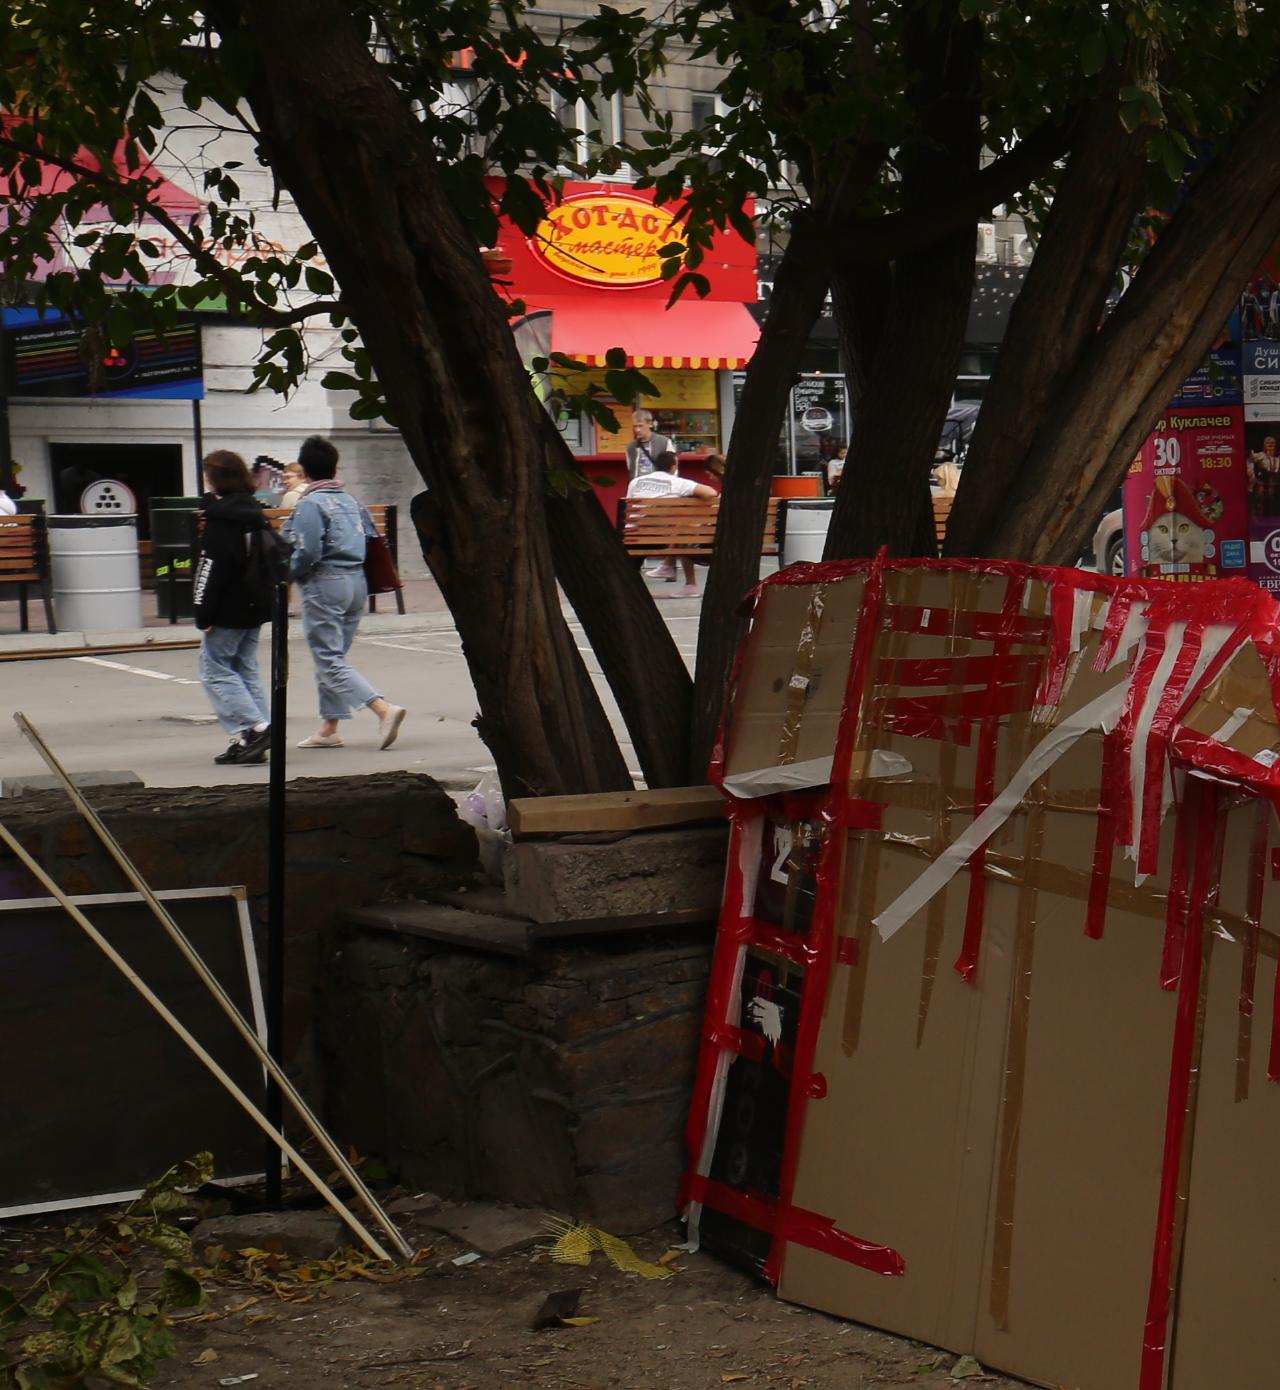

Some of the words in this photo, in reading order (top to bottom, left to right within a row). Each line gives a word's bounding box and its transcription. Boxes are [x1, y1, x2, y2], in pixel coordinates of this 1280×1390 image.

[1170, 416, 1231, 431] Куклачев
[1154, 437, 1181, 467] 30
[1200, 457, 1232, 469] 18:30
